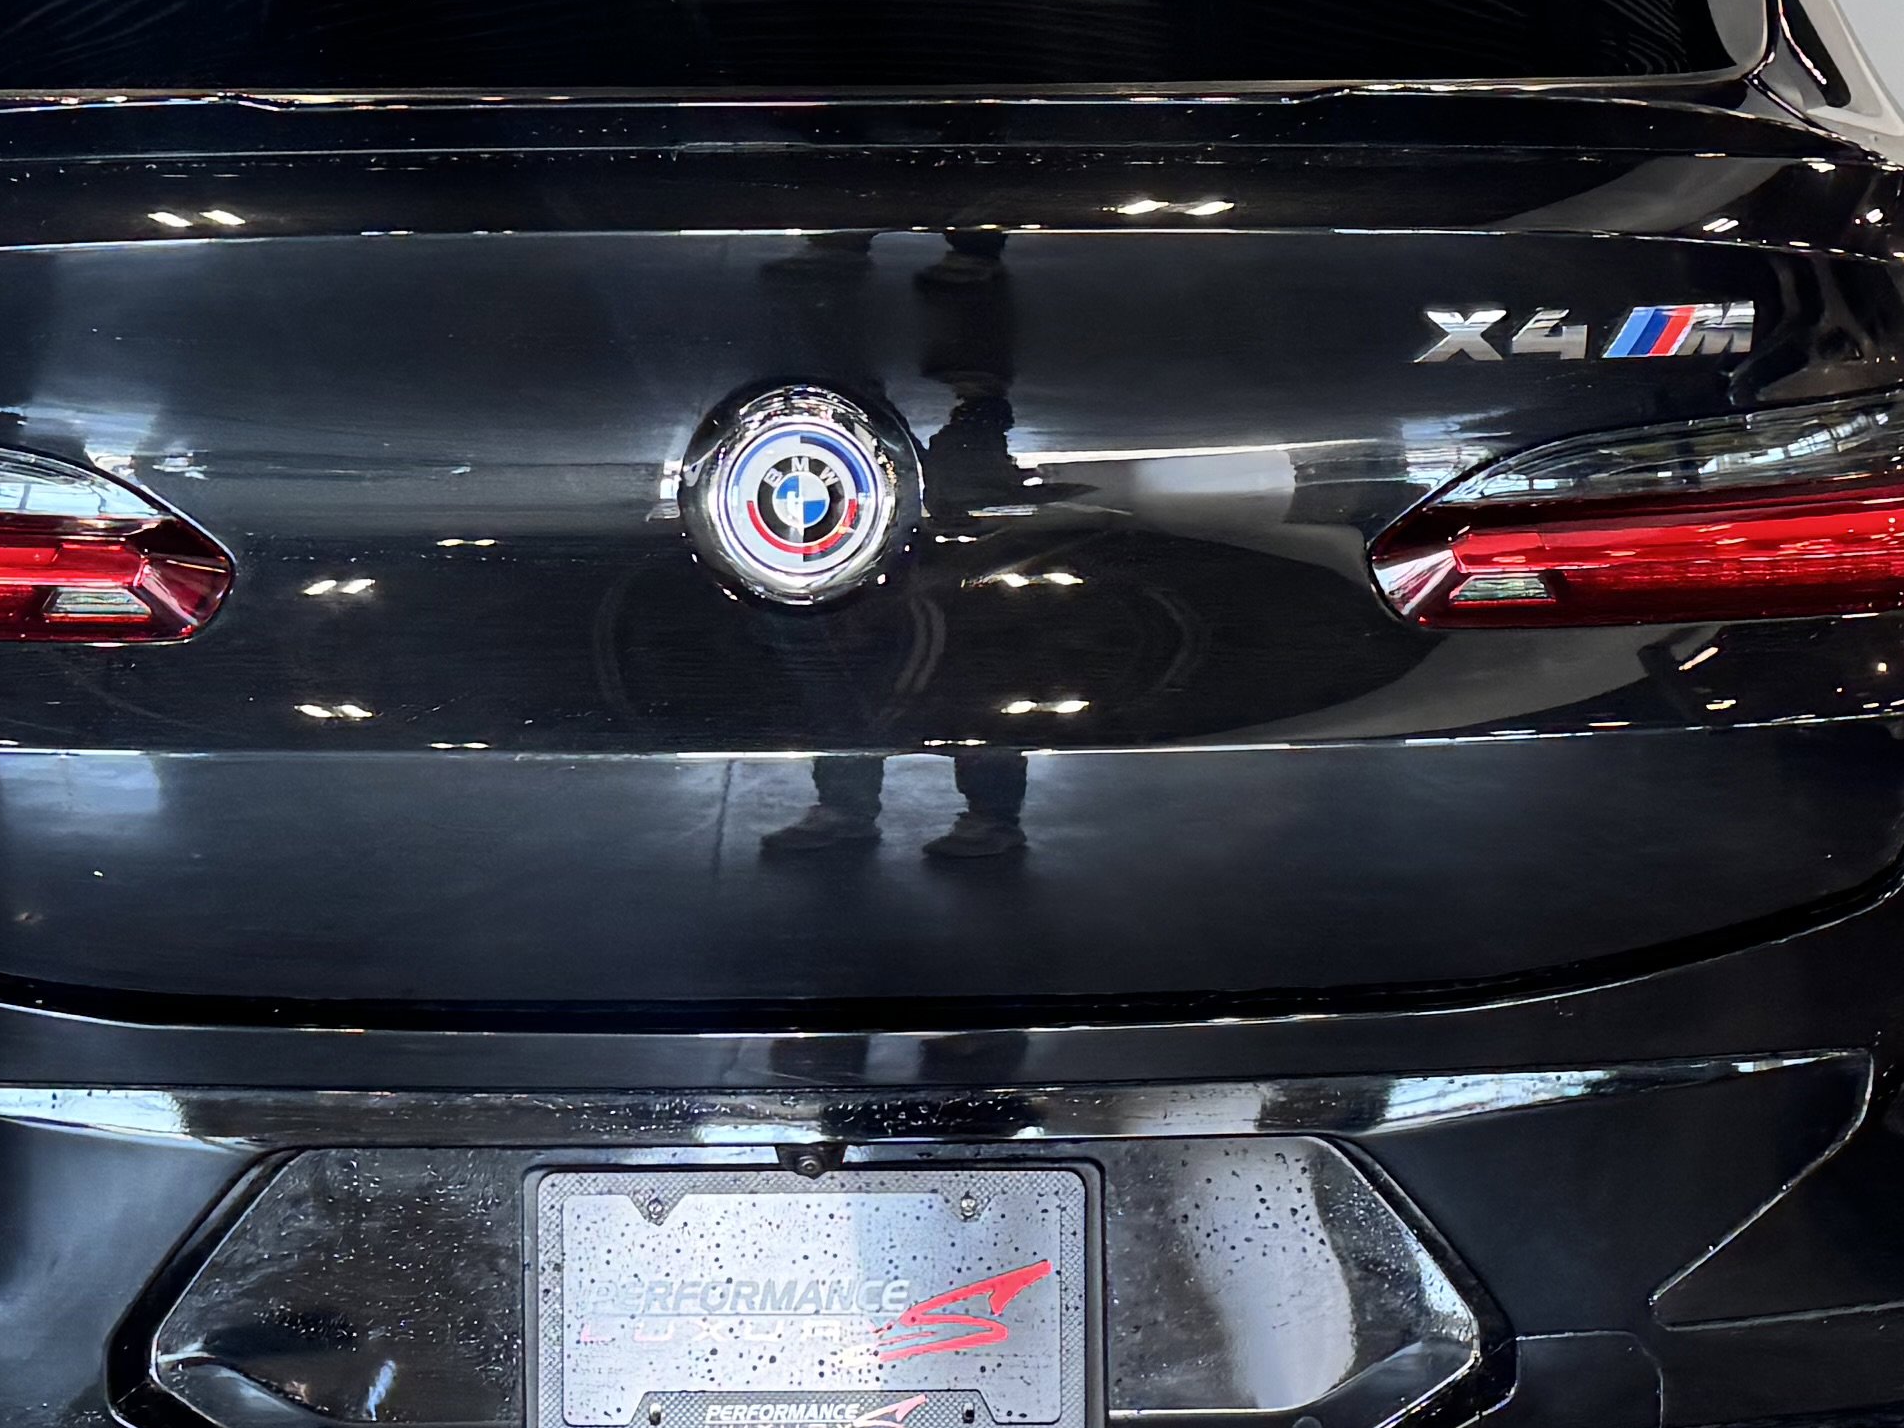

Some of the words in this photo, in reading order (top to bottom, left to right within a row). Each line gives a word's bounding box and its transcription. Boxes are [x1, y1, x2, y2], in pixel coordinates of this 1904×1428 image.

[1413, 307, 1587, 363] X4
[764, 457, 839, 486] BMW
[582, 1279, 911, 1312] PERFORMANCE
[705, 1403, 860, 1421] PERFORMANCE
